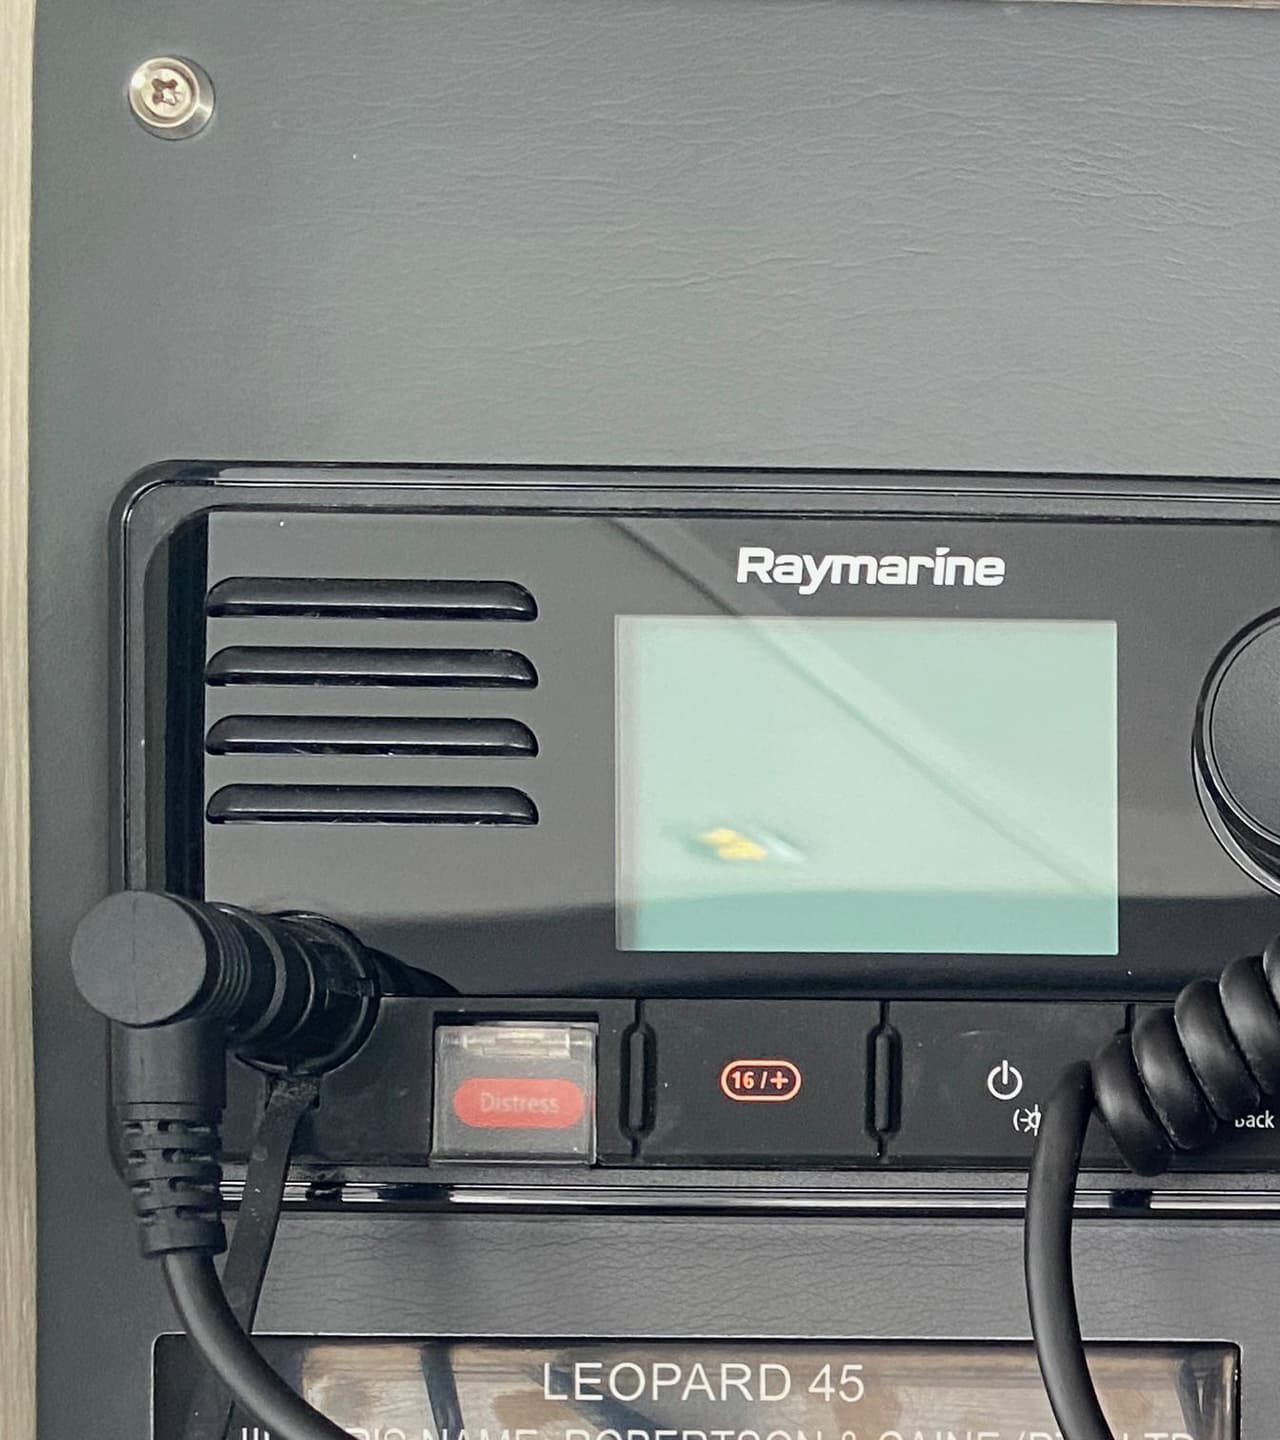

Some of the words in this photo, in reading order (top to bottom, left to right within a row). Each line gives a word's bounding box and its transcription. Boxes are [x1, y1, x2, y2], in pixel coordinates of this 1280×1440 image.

[736, 546, 1006, 595] Raymarine
[479, 1091, 560, 1114] Distress
[542, 1362, 793, 1404] LEOPARD
[807, 1365, 866, 1404] 45
